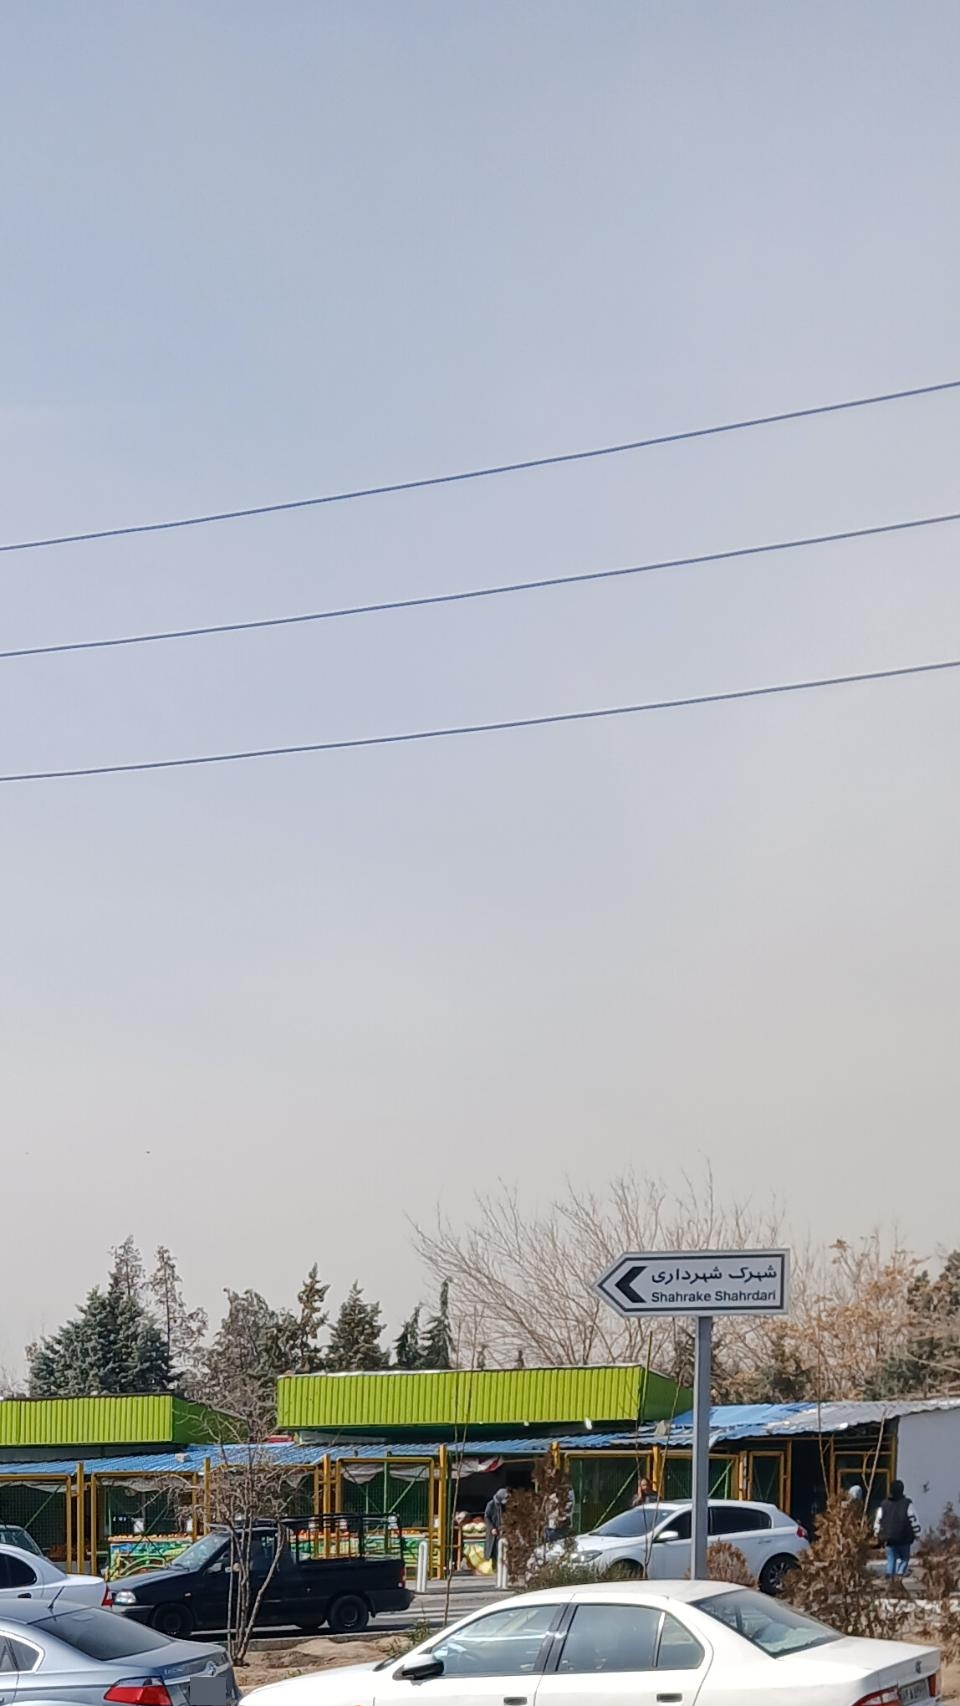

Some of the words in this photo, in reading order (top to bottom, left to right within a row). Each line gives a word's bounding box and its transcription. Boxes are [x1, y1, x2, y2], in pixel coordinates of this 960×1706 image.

[651, 1265, 723, 1285] شهرداری
[728, 1264, 777, 1283] شهرک
[651, 1290, 712, 1303] Shahrake
[714, 1289, 777, 1302] Shahrdari
